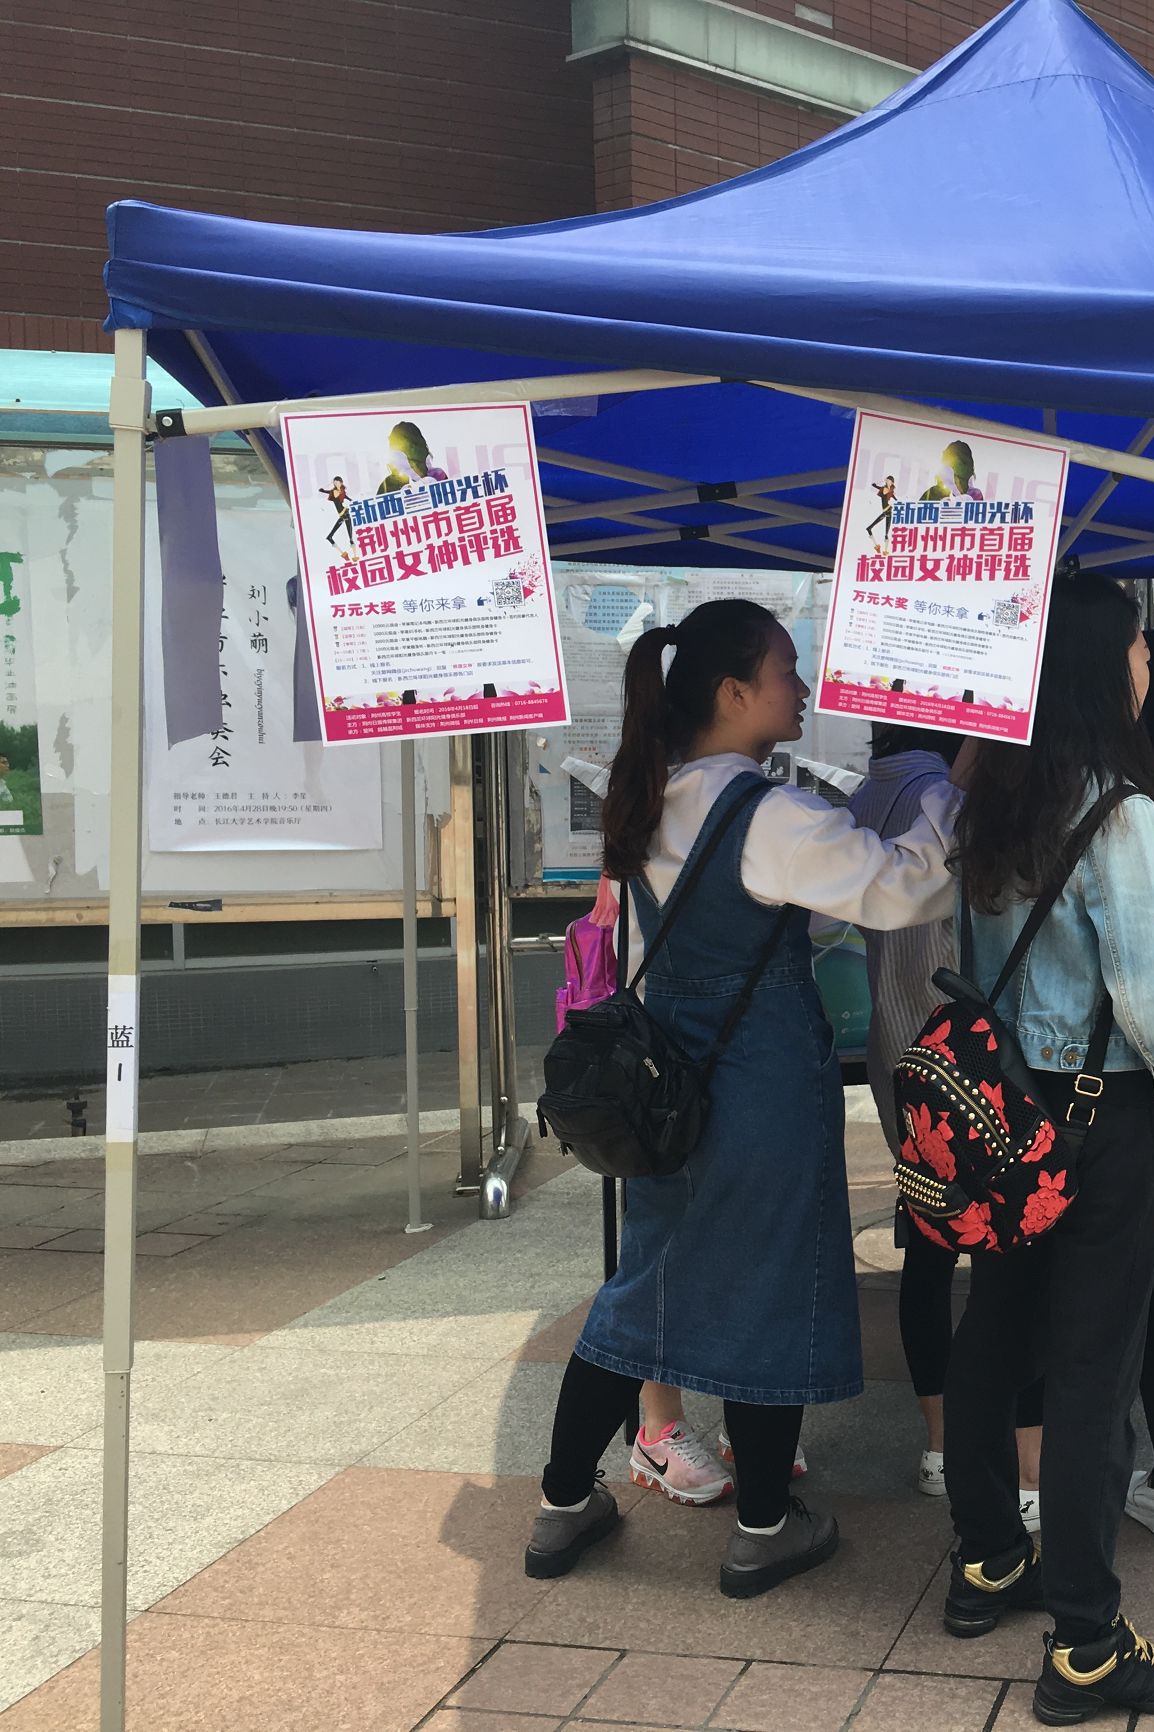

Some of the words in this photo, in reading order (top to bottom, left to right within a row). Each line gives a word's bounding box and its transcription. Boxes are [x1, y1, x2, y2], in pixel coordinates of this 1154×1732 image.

[349, 468, 509, 526] 新西兰阳光杯
[356, 494, 517, 557] 荆州市首届
[892, 501, 1034, 525] 新西兰阳光杯
[891, 526, 1034, 553] 荆州市首届
[326, 525, 523, 596] 校园女神评选
[856, 553, 1032, 582] 校园女神评选
[248, 585, 269, 654] 刘小萌
[330, 600, 396, 617] 万元大奖
[402, 596, 467, 613] 等你来拿
[852, 589, 909, 610] 万元大奖
[914, 599, 970, 620] 等你来拿
